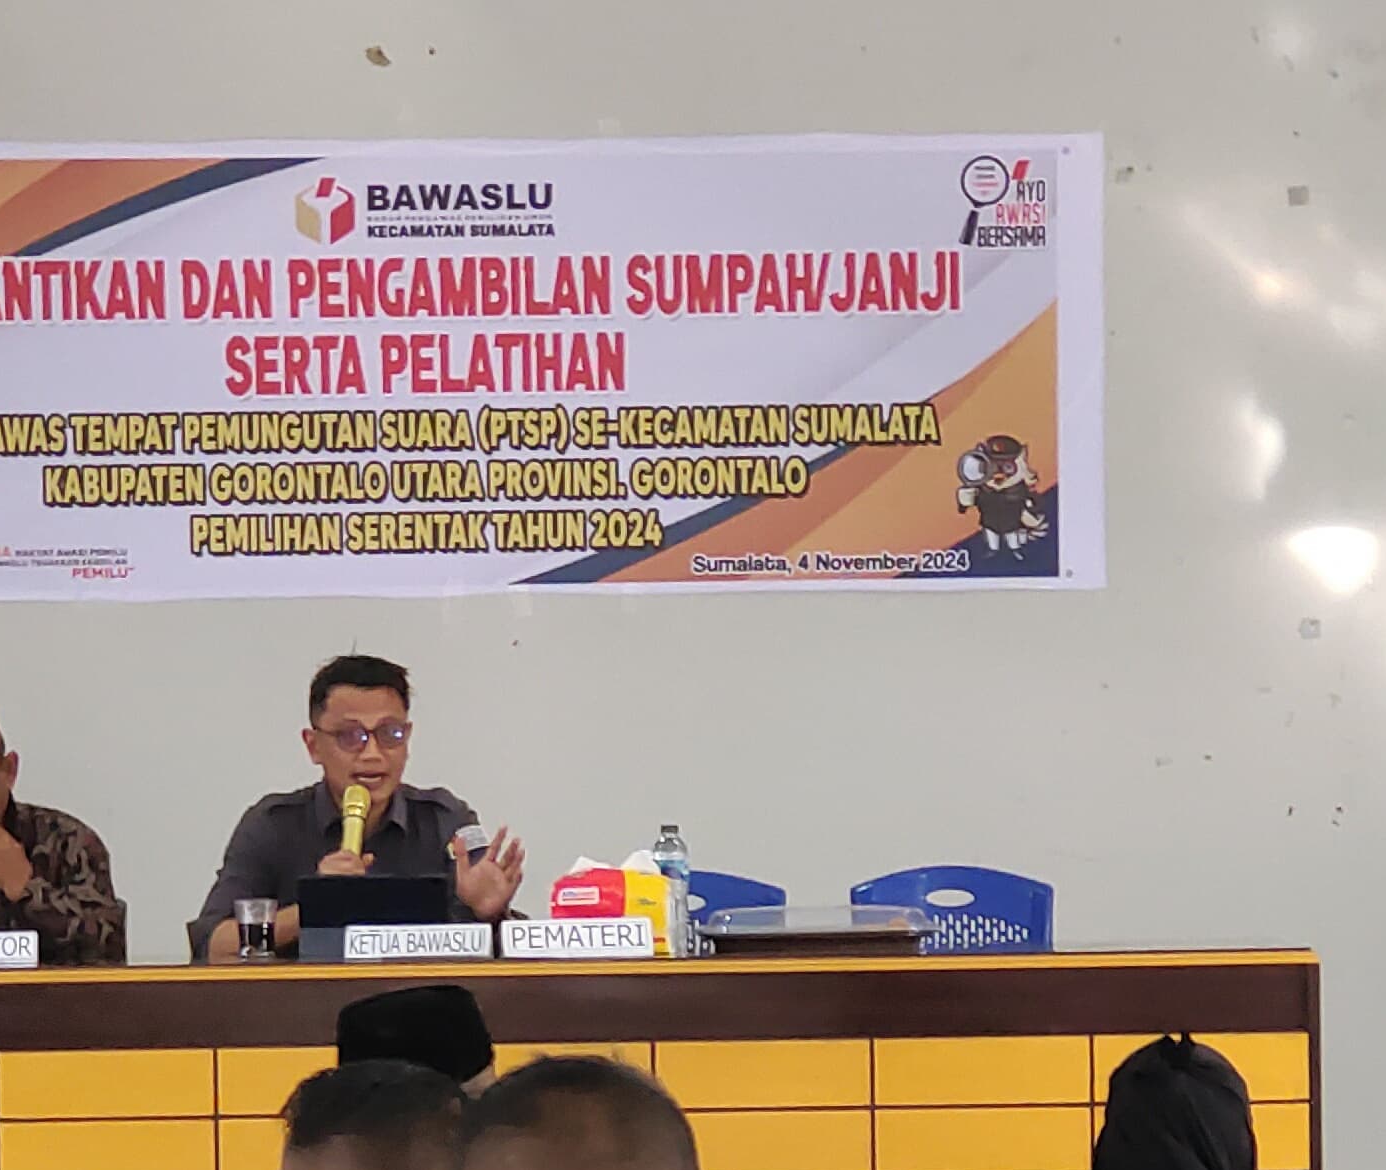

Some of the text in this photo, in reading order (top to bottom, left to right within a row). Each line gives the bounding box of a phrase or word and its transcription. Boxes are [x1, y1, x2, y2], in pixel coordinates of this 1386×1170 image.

[367, 183, 553, 211] BAWASLU
[1016, 180, 1046, 202] AYO
[367, 223, 555, 238] KECAMATAN SUMALATA
[977, 225, 1046, 247] BERSAMA
[181, 257, 273, 321] DAN
[287, 254, 611, 320] PENGAMBILAN
[626, 250, 961, 316] SUMPAH/JANJI
[224, 331, 626, 396] SERTA PELATIHAN
[67, 413, 178, 455] TEMPAT
[182, 411, 375, 454] PEMUNGUTAN
[380, 409, 473, 451] SUARA
[478, 405, 569, 452] (PTSP)
[572, 405, 789, 448] SE-KECAMATAN
[792, 403, 942, 445] SUMALATA
[42, 457, 810, 507] KABUPATEN GORONTALO UTARA PROVINSI. GORONTALO
[190, 508, 664, 556] PEMILIHAN SERENTAK TAHUN 2024
[693, 553, 970, 575] Sumalata, 4 November 2024
[349, 931, 482, 955] KETUA BAWASLU
[512, 924, 646, 949] PEMATERI
